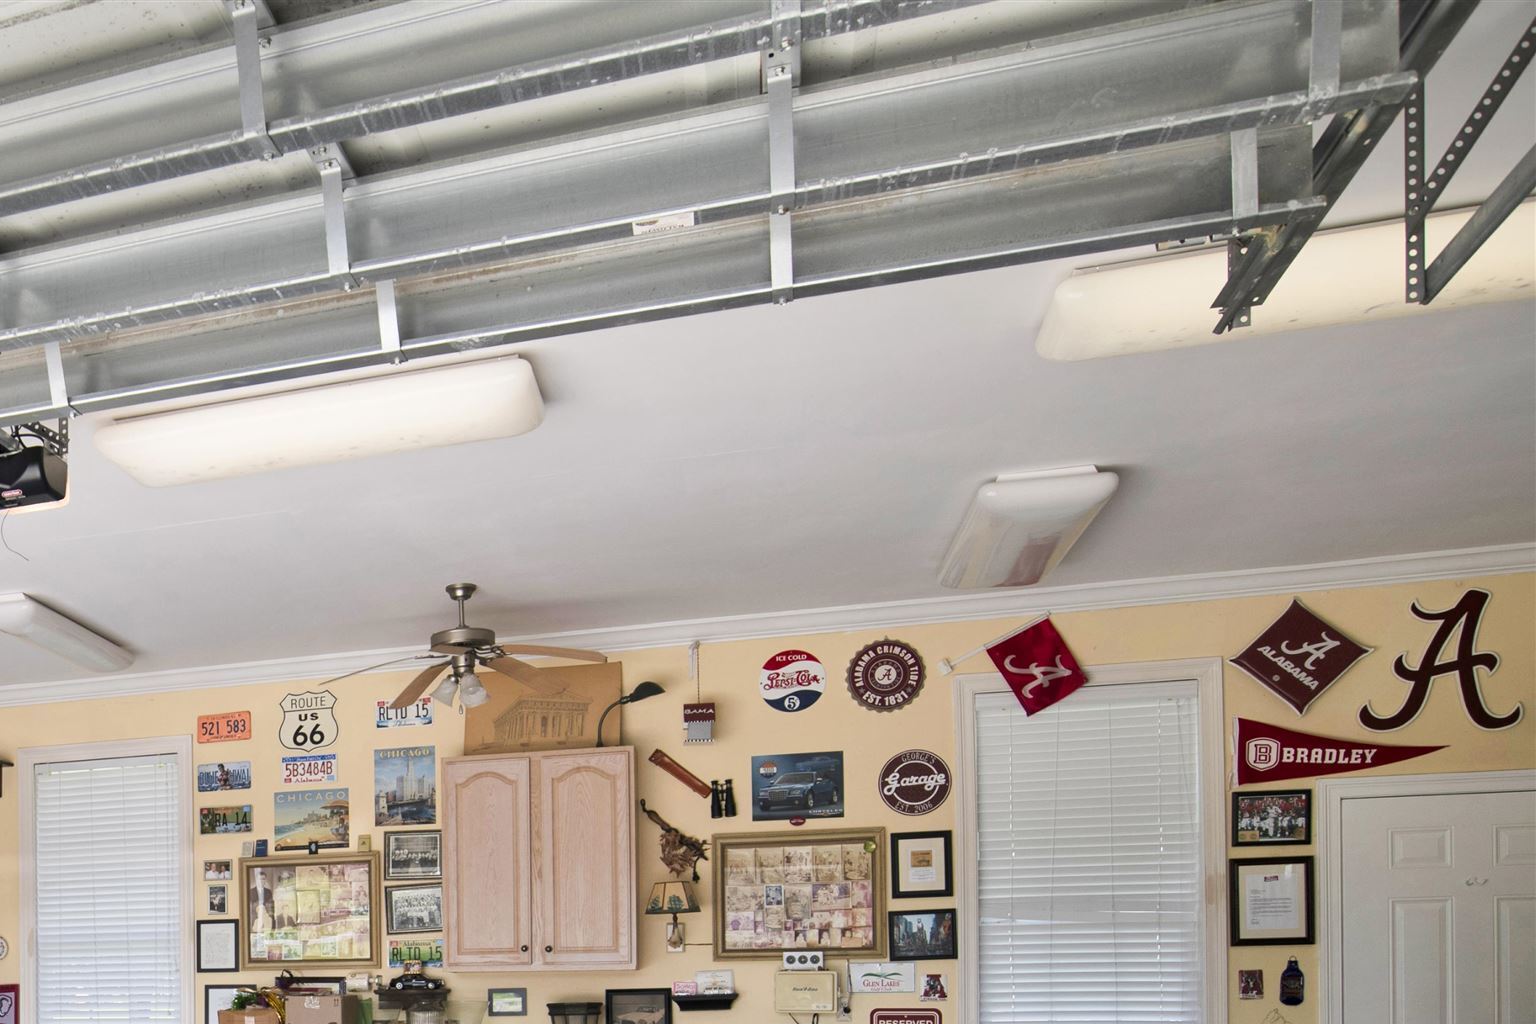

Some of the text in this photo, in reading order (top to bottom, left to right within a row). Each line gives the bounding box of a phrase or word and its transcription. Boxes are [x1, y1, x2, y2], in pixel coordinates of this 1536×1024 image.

[854, 645, 919, 687] ALABAMA CRIMSON TIDE
[1256, 645, 1319, 690] ALABAMA
[1358, 588, 1524, 732] A
[290, 696, 326, 709] ROUTE
[862, 690, 909, 706] EST. 1831
[298, 712, 319, 722] US
[414, 703, 429, 718] 15
[201, 719, 246, 736] 521 583
[292, 723, 325, 747] 66
[379, 749, 430, 758] CHICAGO
[901, 752, 936, 765] GEORGE'S
[1282, 747, 1378, 764] BRADLEY
[285, 761, 333, 777] 5B3484B
[883, 771, 947, 795] Garage
[276, 790, 346, 803] CHICAGO
[914, 801, 933, 813] 2006
[429, 946, 443, 961] 15
[862, 979, 900, 987] GLEN LAKES
